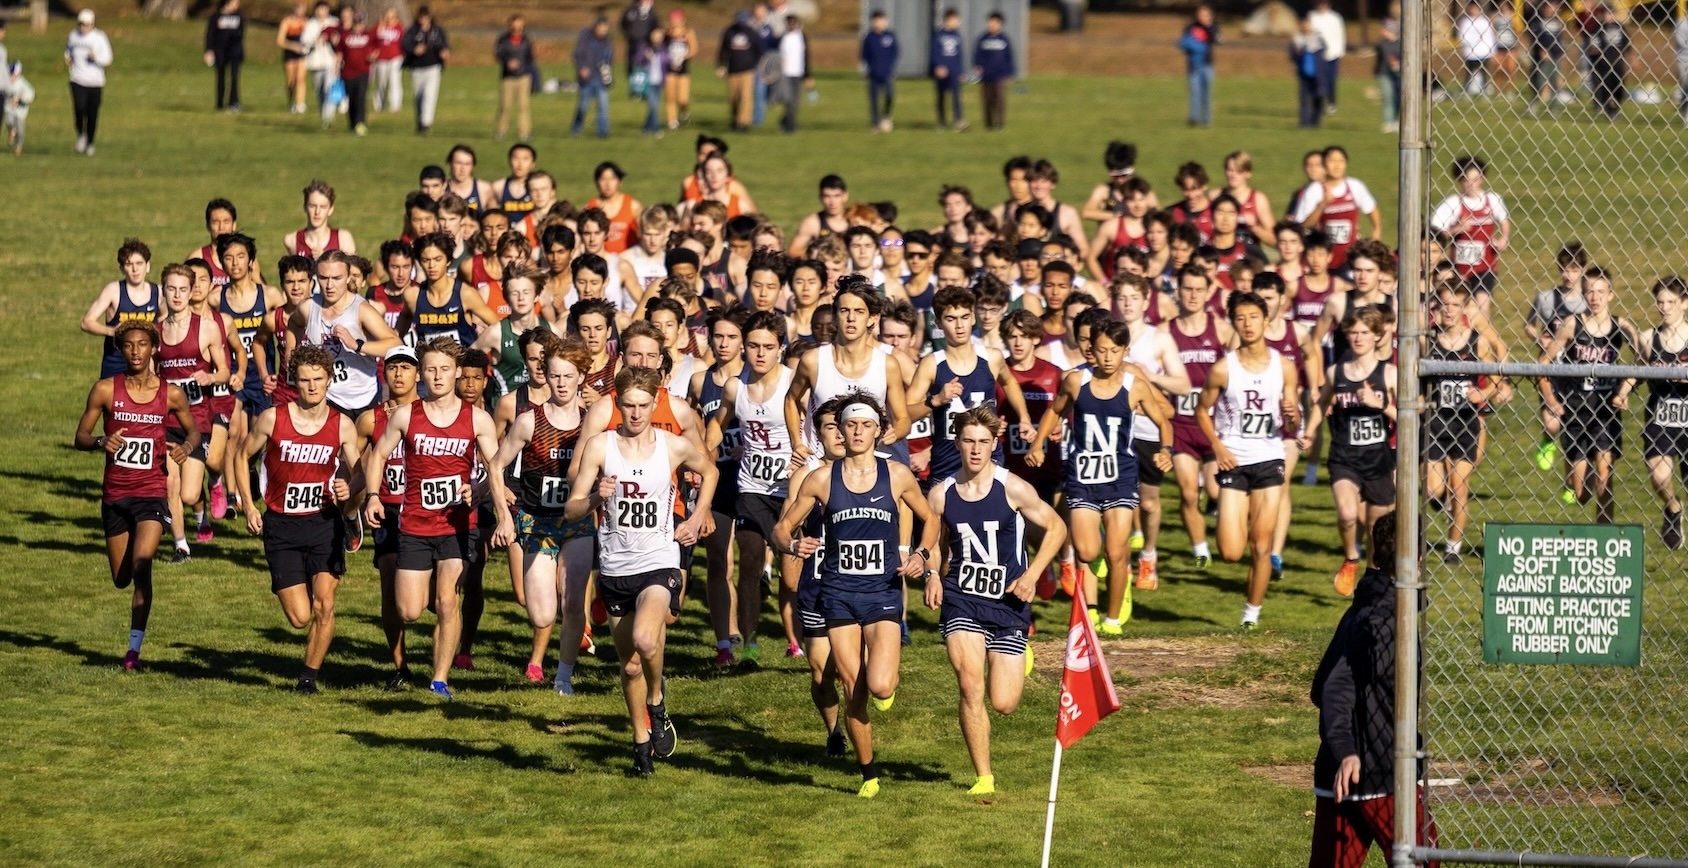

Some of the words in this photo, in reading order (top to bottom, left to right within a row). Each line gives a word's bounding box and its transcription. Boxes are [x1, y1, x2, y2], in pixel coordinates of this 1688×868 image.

[233, 317, 263, 328] B&N
[419, 313, 459, 325] BB&N
[1179, 350, 1217, 363] OPKINS
[1024, 392, 1054, 401] CESTER
[1181, 391, 1199, 411] 20
[114, 411, 164, 425] MIDDLESEX
[746, 420, 781, 451] RL
[1084, 414, 1122, 453] N
[1352, 419, 1382, 441] 359
[117, 441, 151, 465] 228
[279, 440, 334, 465] TABOR
[414, 433, 470, 457] TABOR
[752, 454, 787, 482] 282
[1079, 455, 1117, 480] 270
[287, 486, 322, 509] 348
[423, 478, 458, 506] 351
[618, 501, 658, 529] 288
[832, 507, 892, 525] WILLISTON
[957, 520, 999, 564] N
[1498, 537, 1525, 556] NO
[1532, 538, 1598, 556] PEPPER
[1605, 539, 1631, 557] OR
[841, 543, 882, 570] 394
[1513, 556, 1560, 575] SOFT
[1568, 557, 1616, 576] TOSS
[961, 564, 1003, 596] 268
[1497, 574, 1555, 593] AGAINST
[1560, 576, 1632, 594] BACKSTOP
[1496, 597, 1554, 615] BATTING
[1560, 598, 1631, 617] PRACTICE
[1507, 616, 1548, 634] FROM
[1553, 617, 1618, 636] PITCHING
[1513, 635, 1569, 653] RUBBER
[1575, 636, 1612, 654] ONLY
